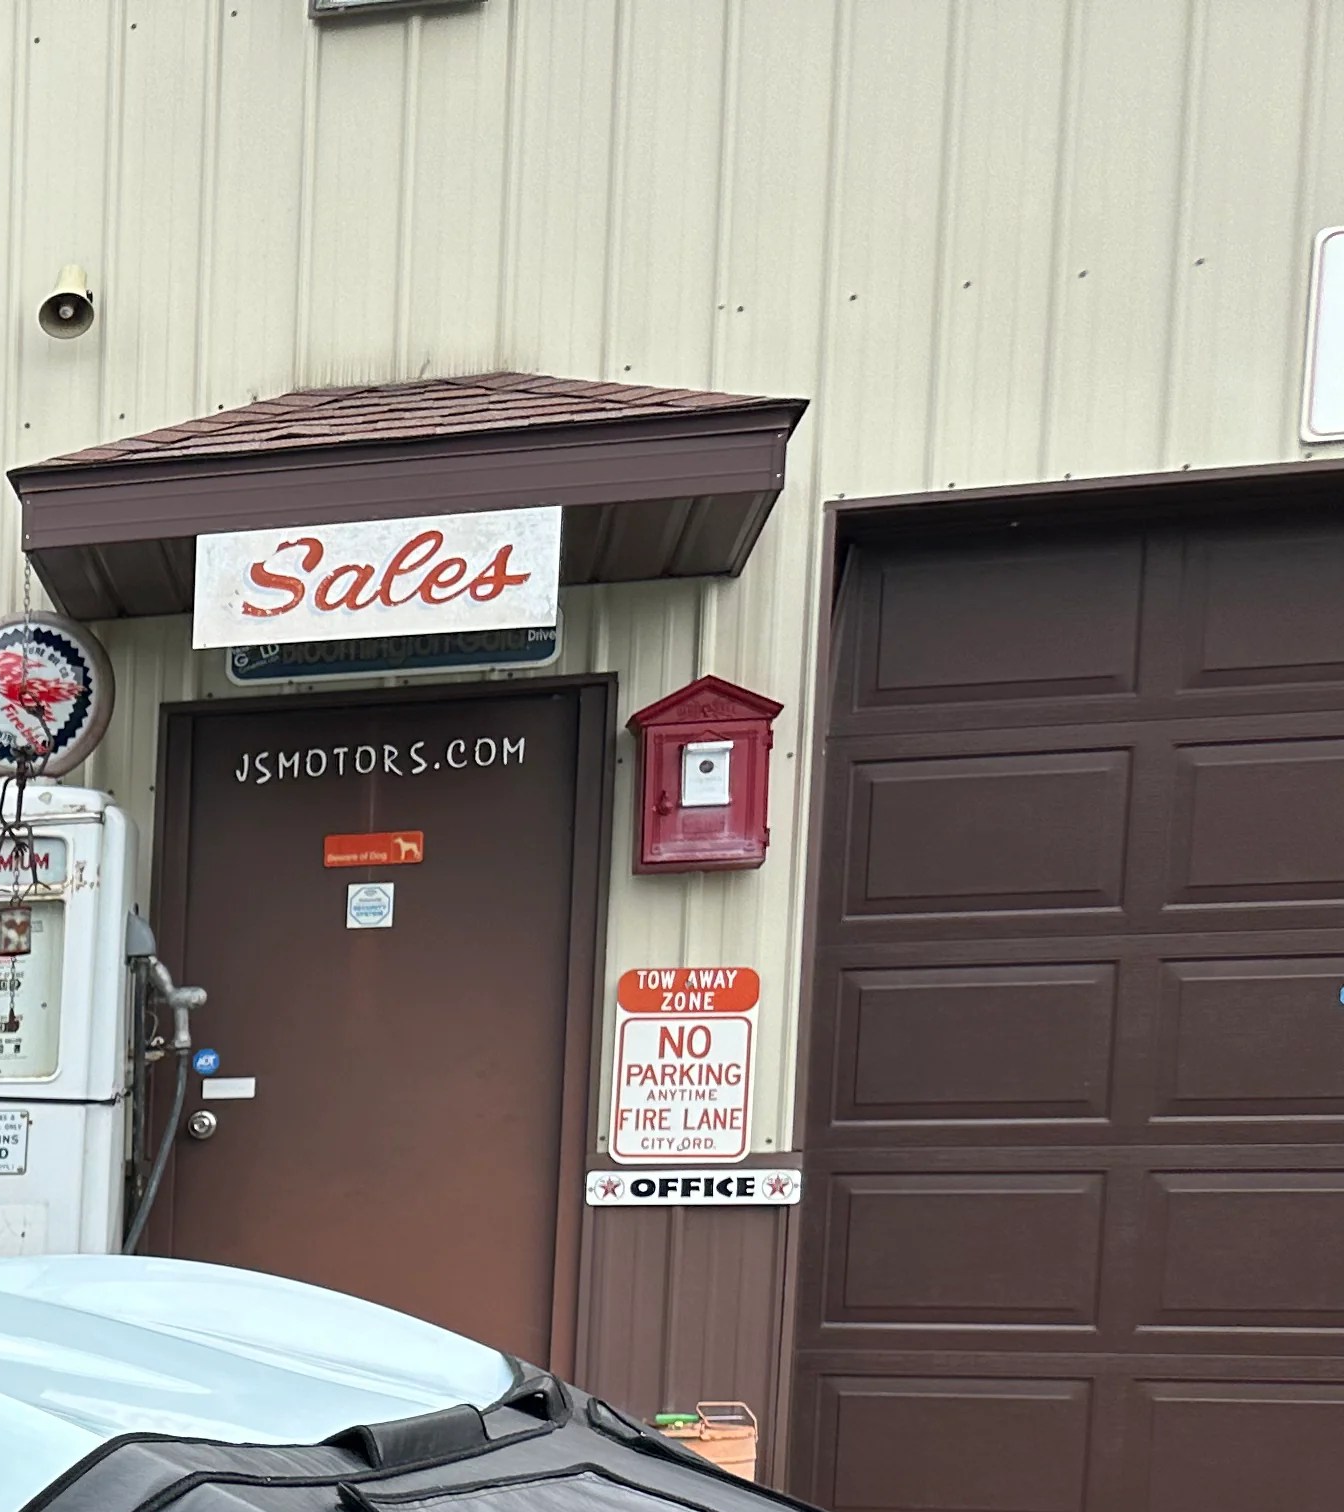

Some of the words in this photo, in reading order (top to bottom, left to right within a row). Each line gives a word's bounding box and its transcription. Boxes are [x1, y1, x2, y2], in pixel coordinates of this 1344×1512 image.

[241, 530, 532, 617] Sales
[235, 737, 526, 784] JSMOTORS.COM
[637, 970, 676, 989] TOW
[686, 970, 738, 989] AWAY
[661, 992, 715, 1011] ZONE
[658, 1025, 712, 1059] NO
[626, 1063, 742, 1086] PARKING
[646, 1089, 718, 1101] ANYTIME
[619, 1108, 671, 1131] FIRE
[683, 1108, 742, 1130] LANE
[641, 1137, 675, 1150] CITY
[630, 1176, 755, 1198] OFFICE
